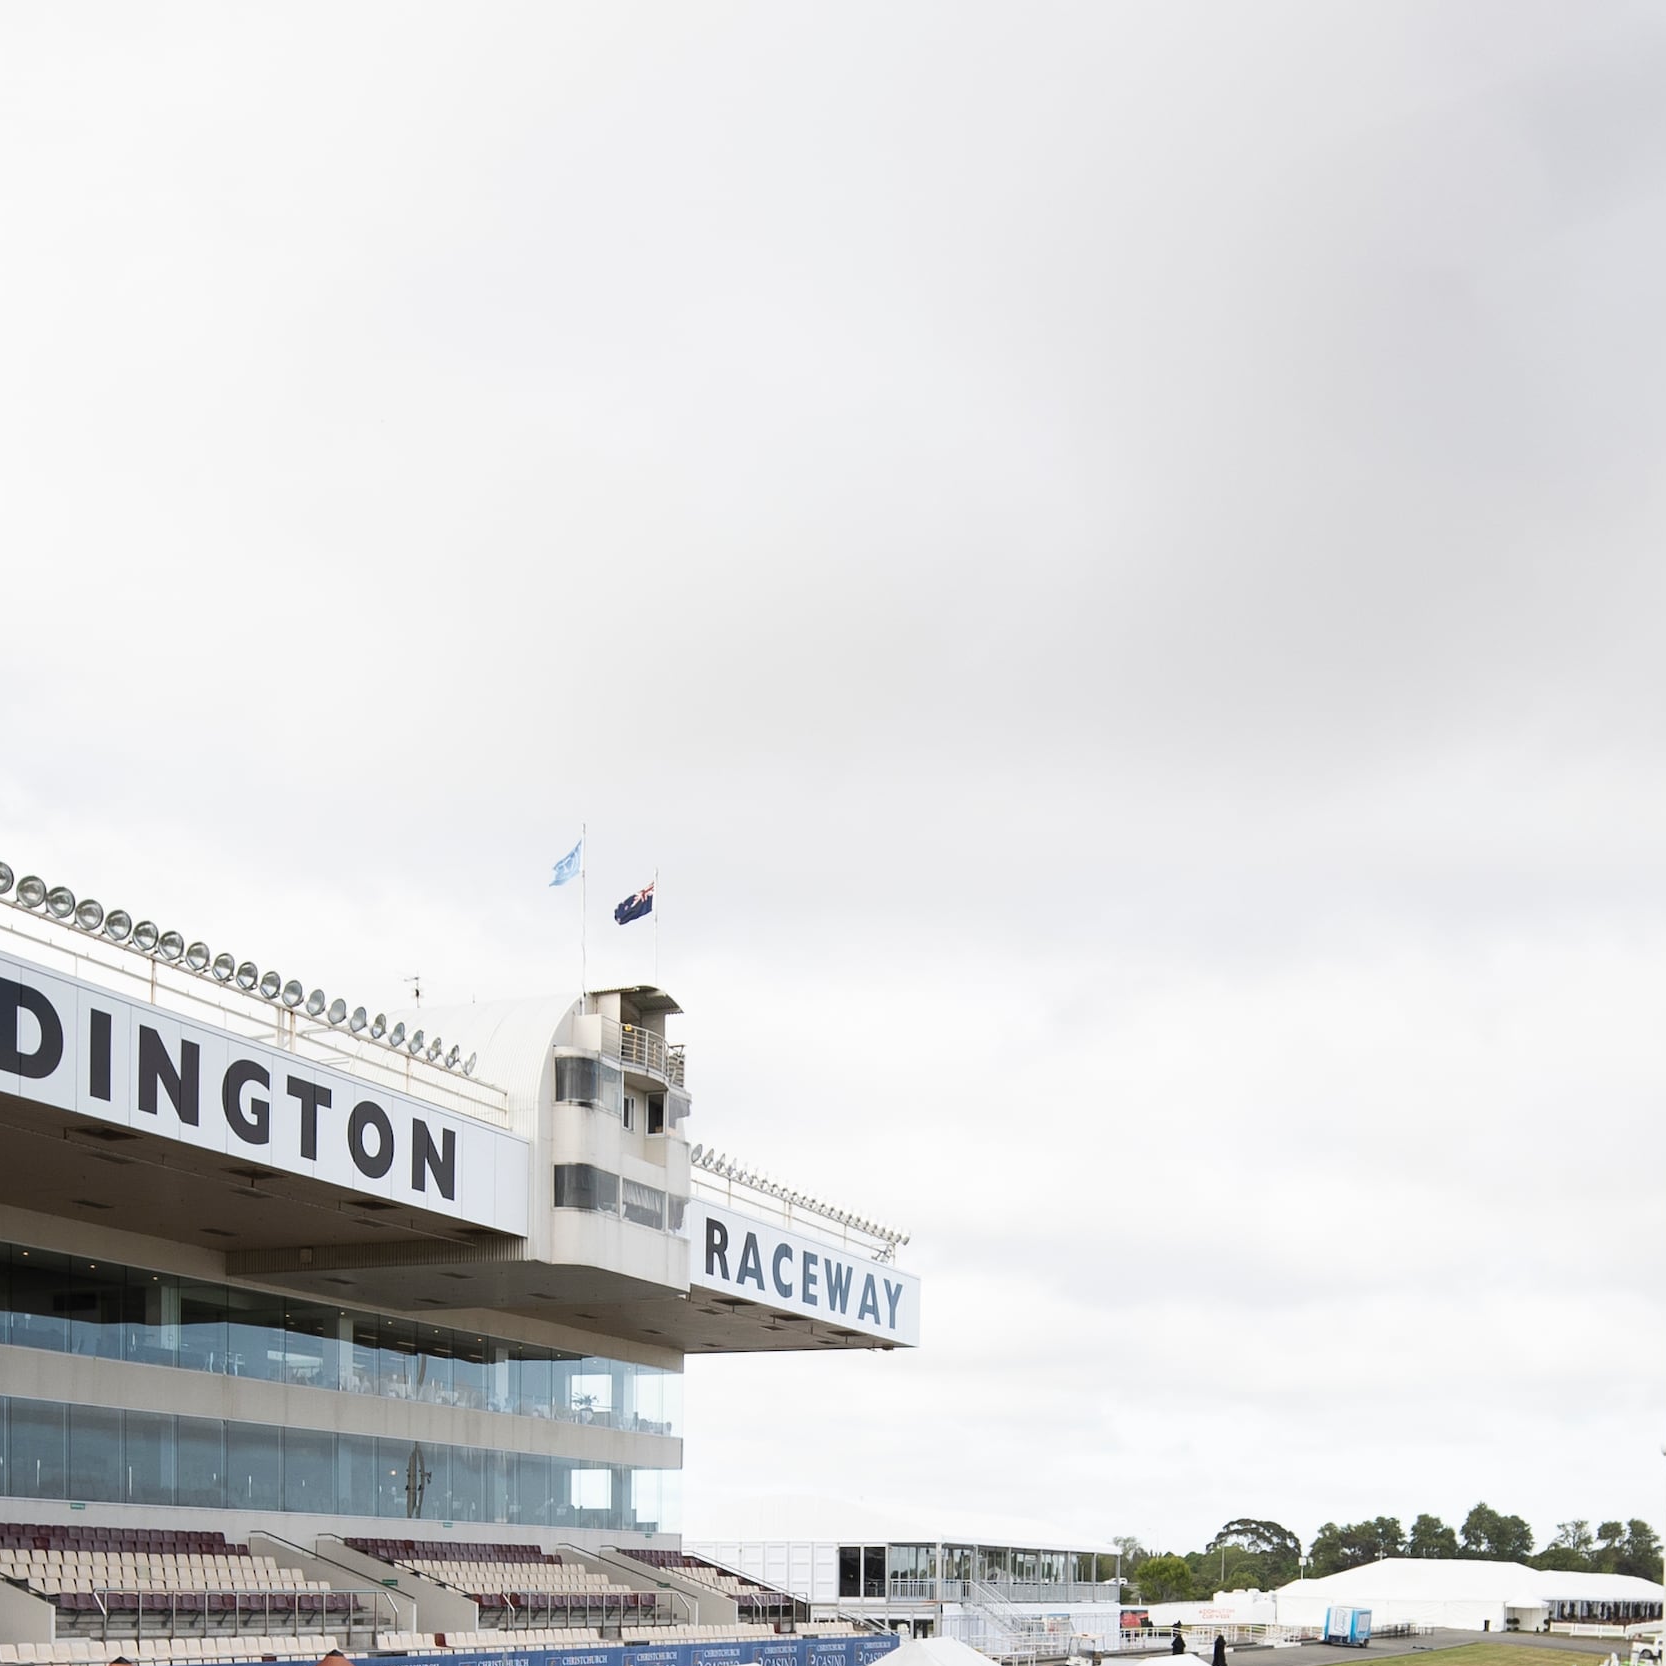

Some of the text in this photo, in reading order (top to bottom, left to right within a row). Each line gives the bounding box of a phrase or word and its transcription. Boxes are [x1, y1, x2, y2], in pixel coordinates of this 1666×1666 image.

[705, 1217, 903, 1329] RACEWAY
[704, 1648, 740, 1658] CHRISTCHURCH
[764, 1645, 797, 1654] CHRISTCHURCH
[562, 1655, 608, 1666] CHRISTCHURCH
[636, 1650, 677, 1662] CHRISTCHURCH
